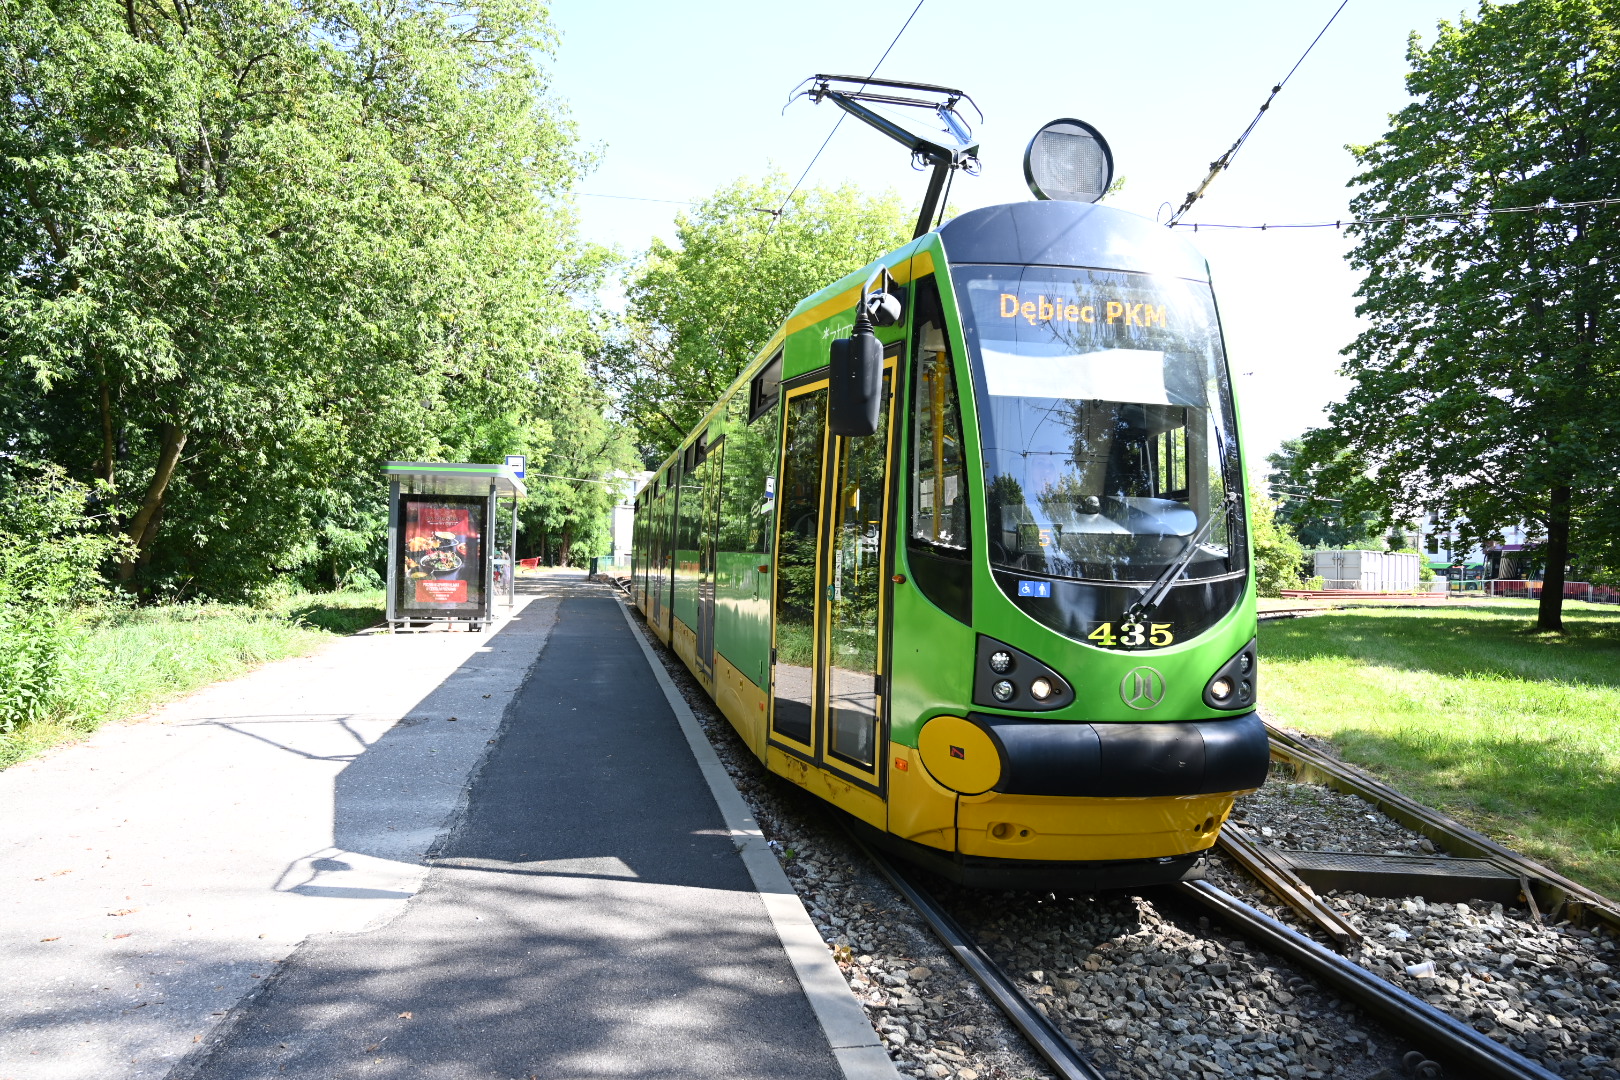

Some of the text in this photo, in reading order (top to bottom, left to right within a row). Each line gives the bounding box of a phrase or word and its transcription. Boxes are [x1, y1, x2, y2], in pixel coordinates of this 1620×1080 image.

[1000, 293, 1167, 328] Dębiec PKM
[1038, 529, 1051, 547] 5
[1087, 622, 1174, 647] 435
